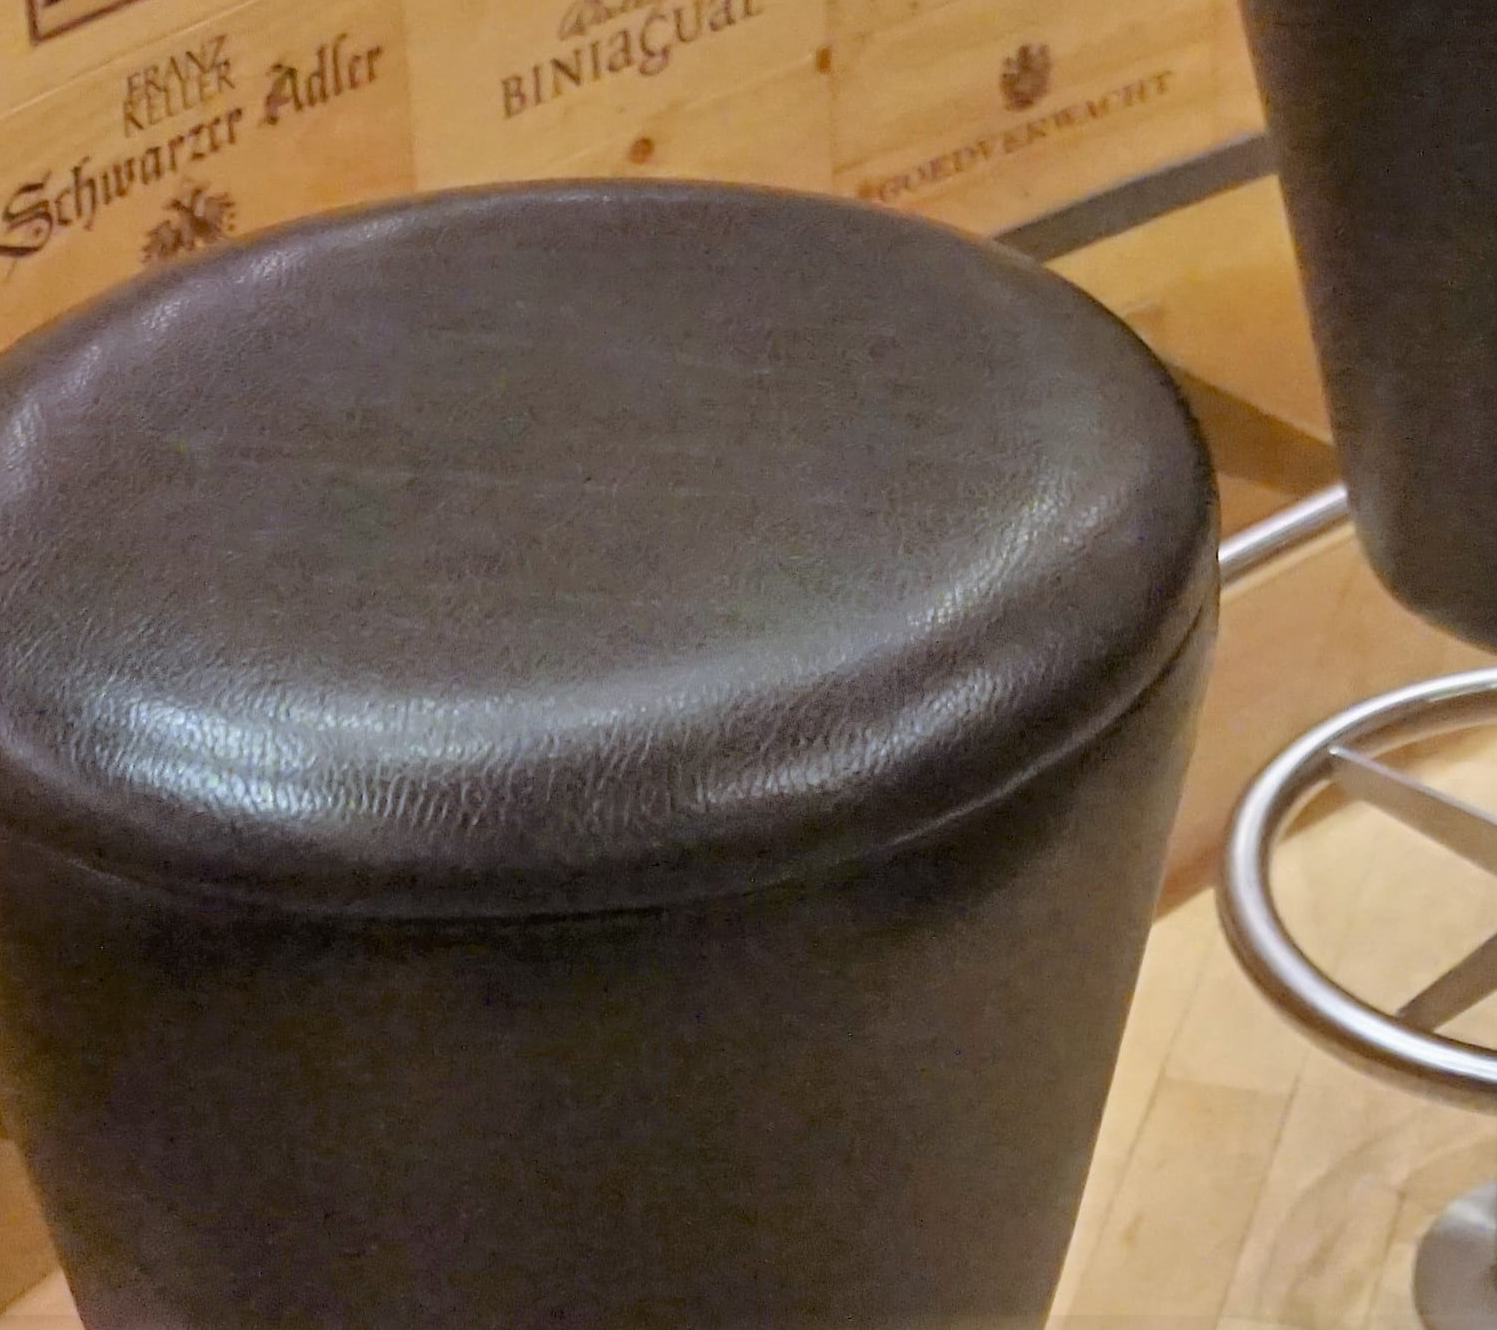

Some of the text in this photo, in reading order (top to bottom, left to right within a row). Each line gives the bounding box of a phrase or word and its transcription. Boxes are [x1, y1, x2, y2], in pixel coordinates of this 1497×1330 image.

[121, 60, 238, 139] KELLER
[124, 34, 228, 105] FRANZ
[258, 31, 386, 129] Adler
